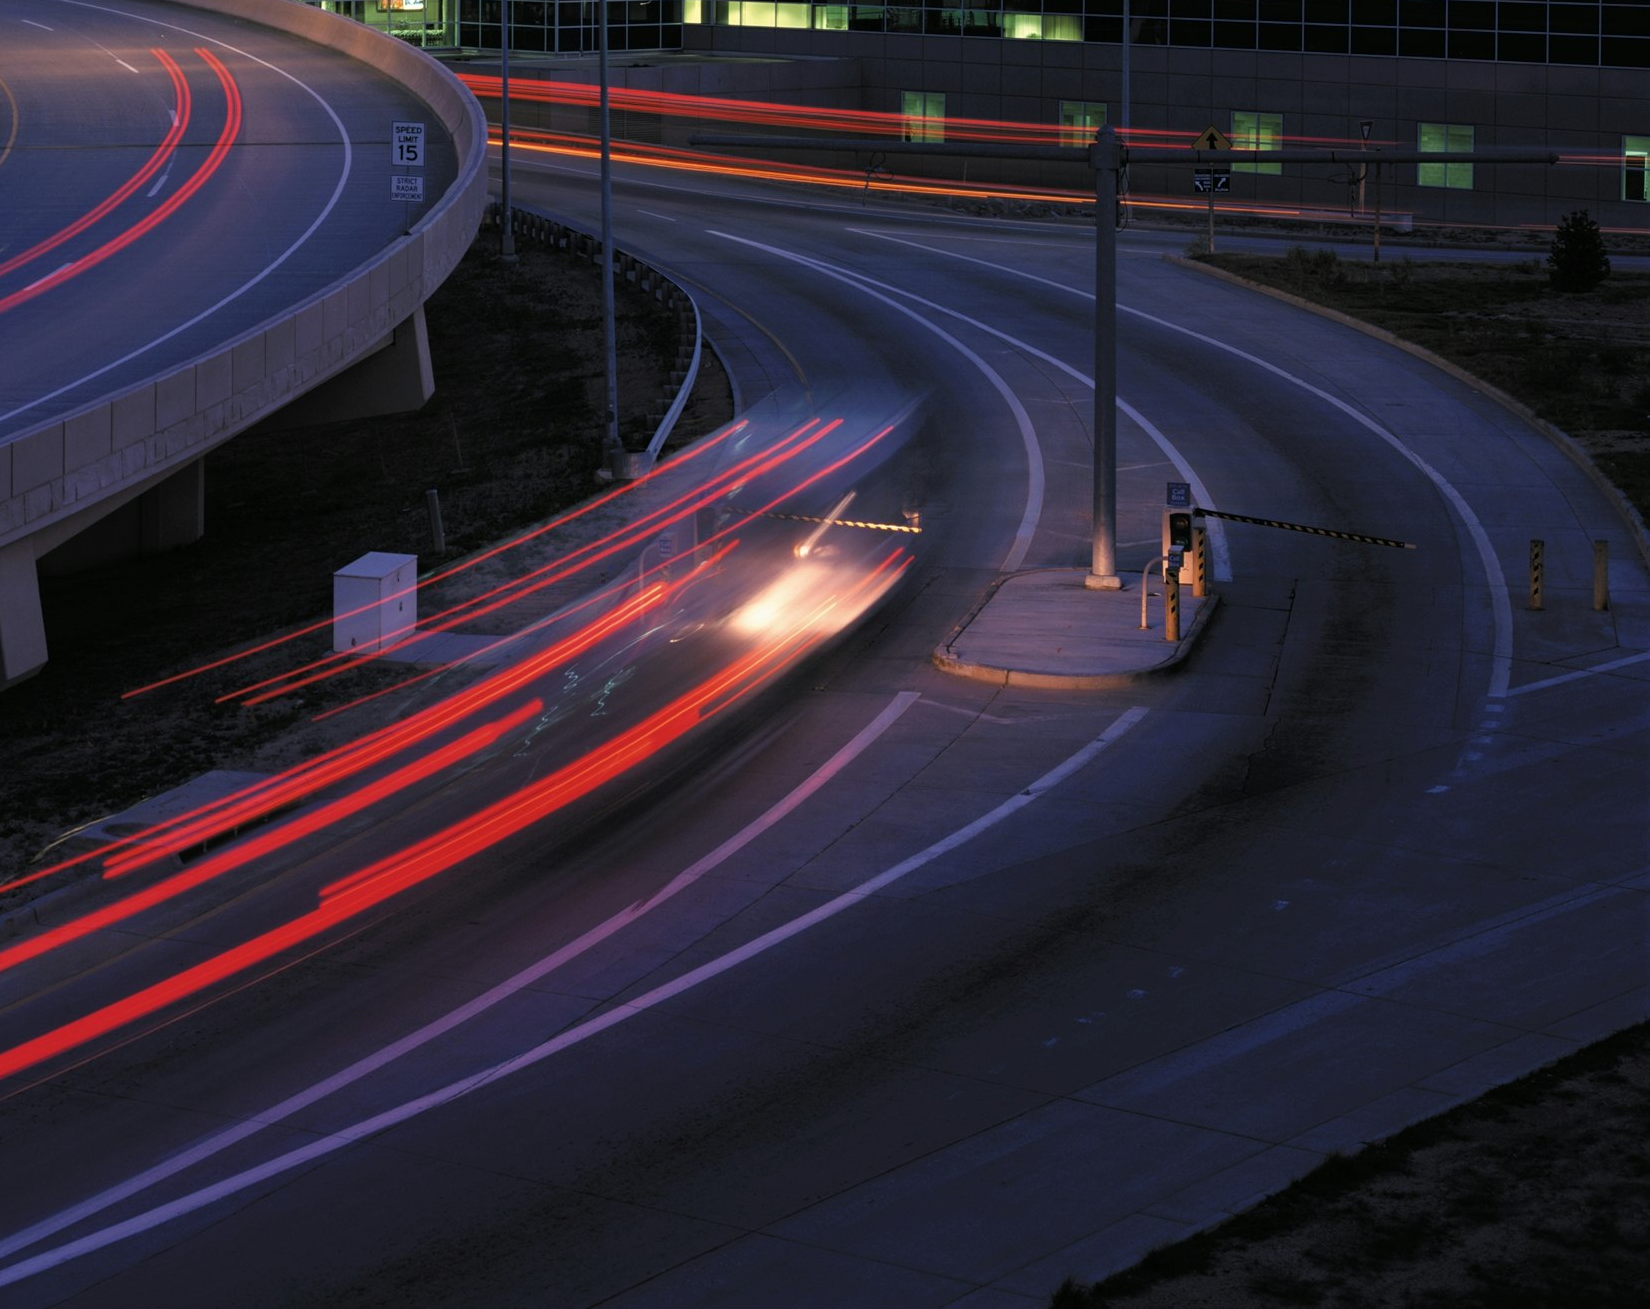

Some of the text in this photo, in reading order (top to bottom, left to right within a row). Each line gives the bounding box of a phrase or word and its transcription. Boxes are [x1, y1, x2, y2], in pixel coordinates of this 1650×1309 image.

[395, 126, 422, 134] SPEED
[398, 144, 418, 161] 15
[396, 177, 418, 185] STRICT
[396, 184, 418, 192] RADAR
